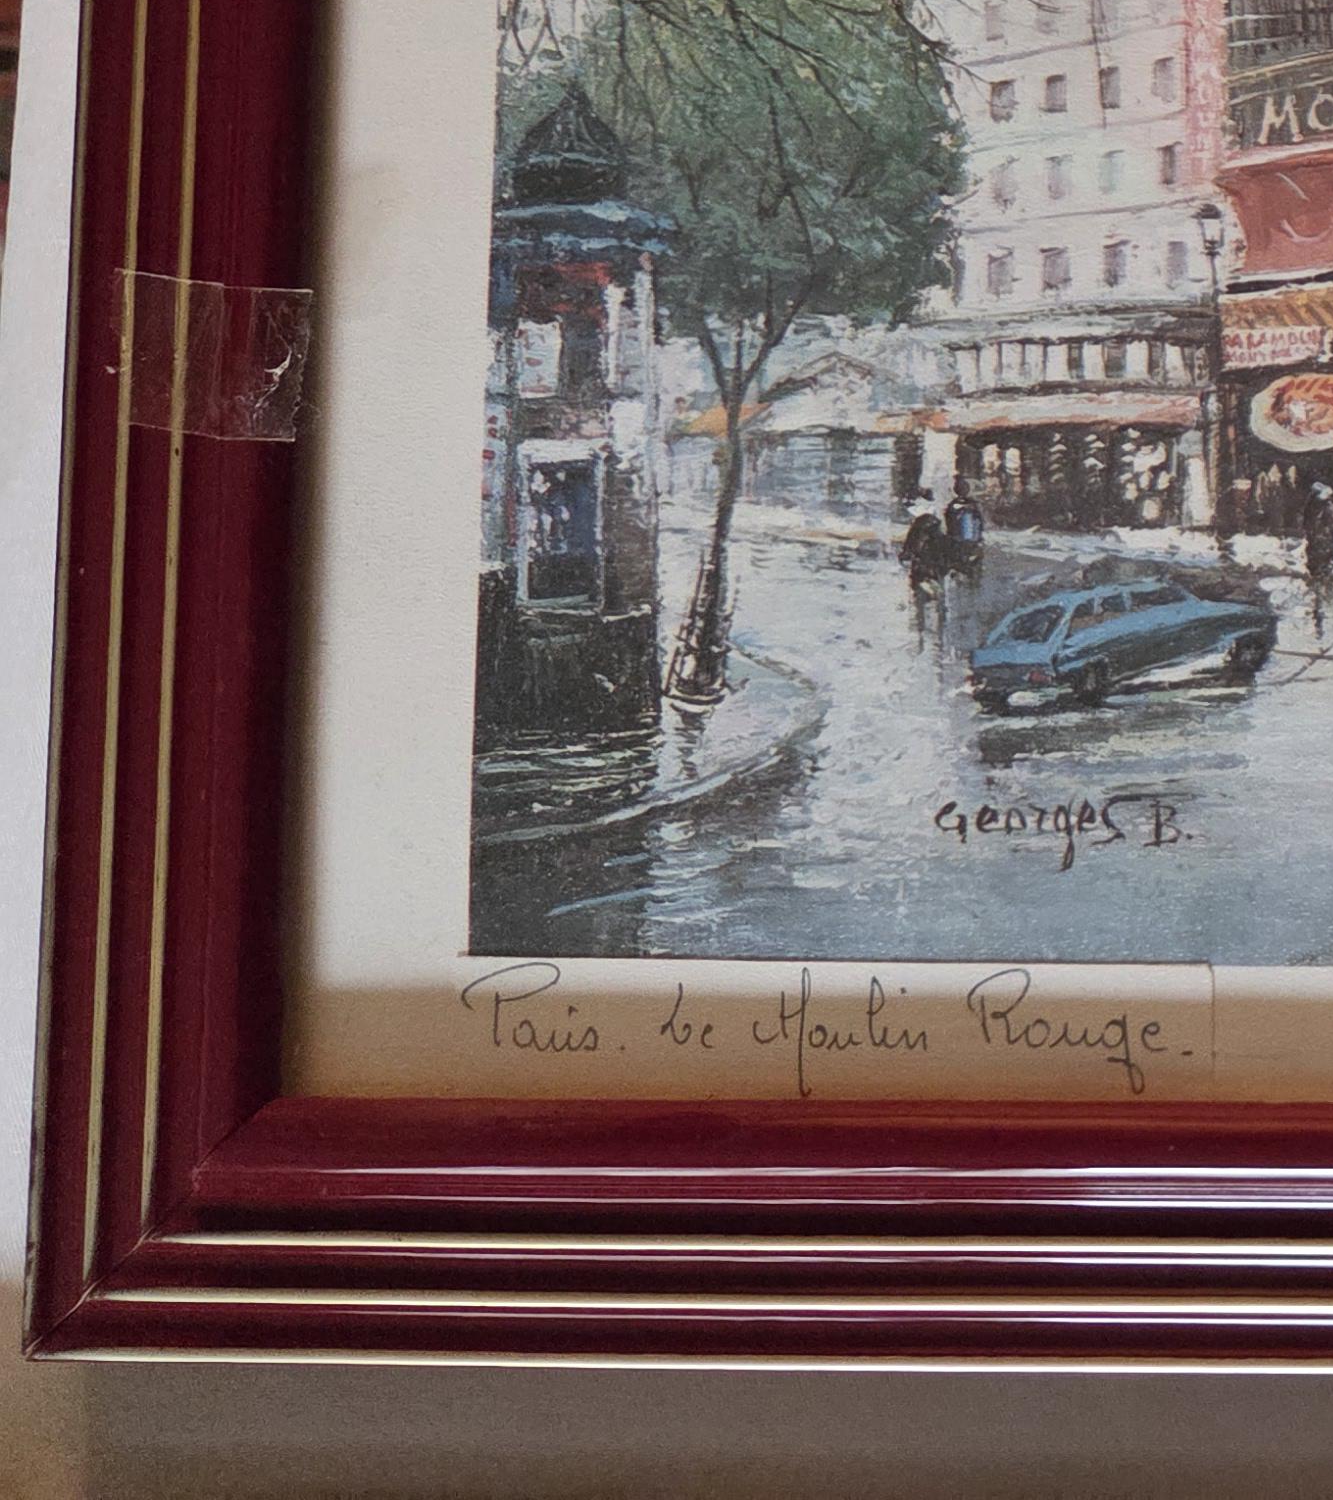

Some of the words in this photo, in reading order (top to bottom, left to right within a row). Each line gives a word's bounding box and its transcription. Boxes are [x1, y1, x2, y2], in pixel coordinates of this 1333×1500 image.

[934, 798, 1126, 872] Georges
[1144, 802, 1197, 847] B.
[752, 966, 928, 1096] Moulin
